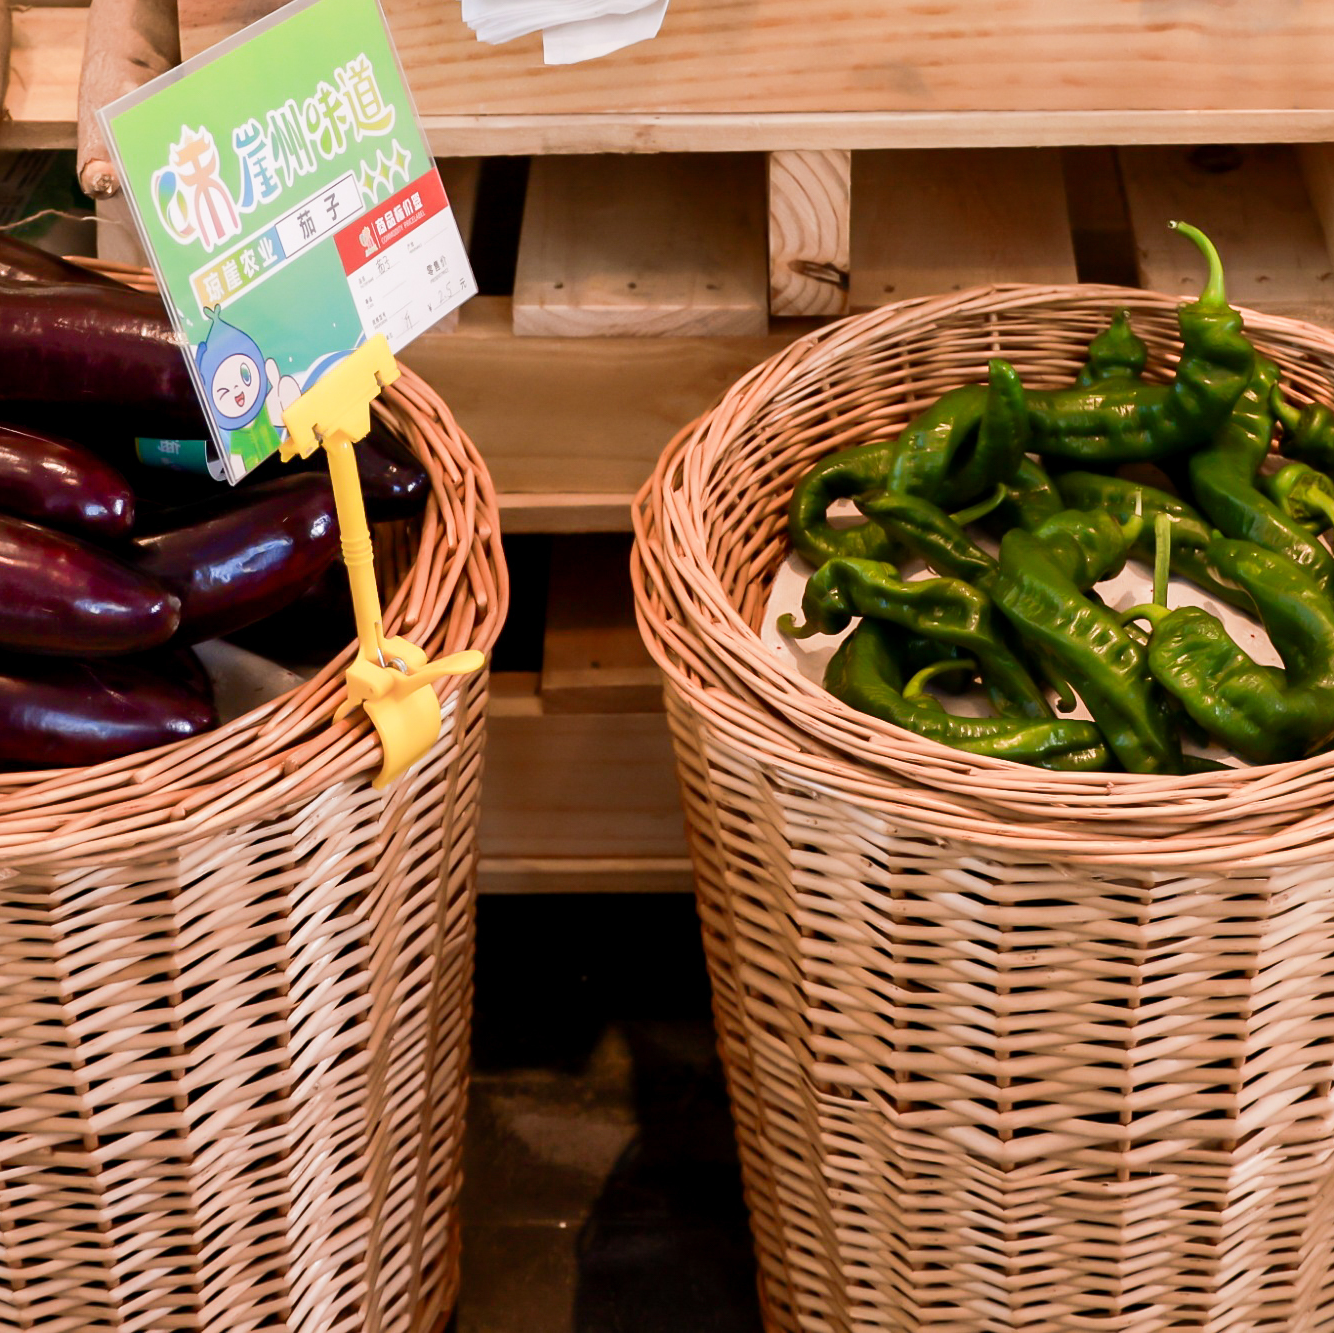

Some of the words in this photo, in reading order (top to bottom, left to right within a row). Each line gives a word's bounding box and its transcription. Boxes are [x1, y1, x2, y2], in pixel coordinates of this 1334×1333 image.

[233, 55, 395, 211] 崖州味道
[202, 236, 278, 303] 琼崖农业
[296, 192, 340, 240] 茄子
